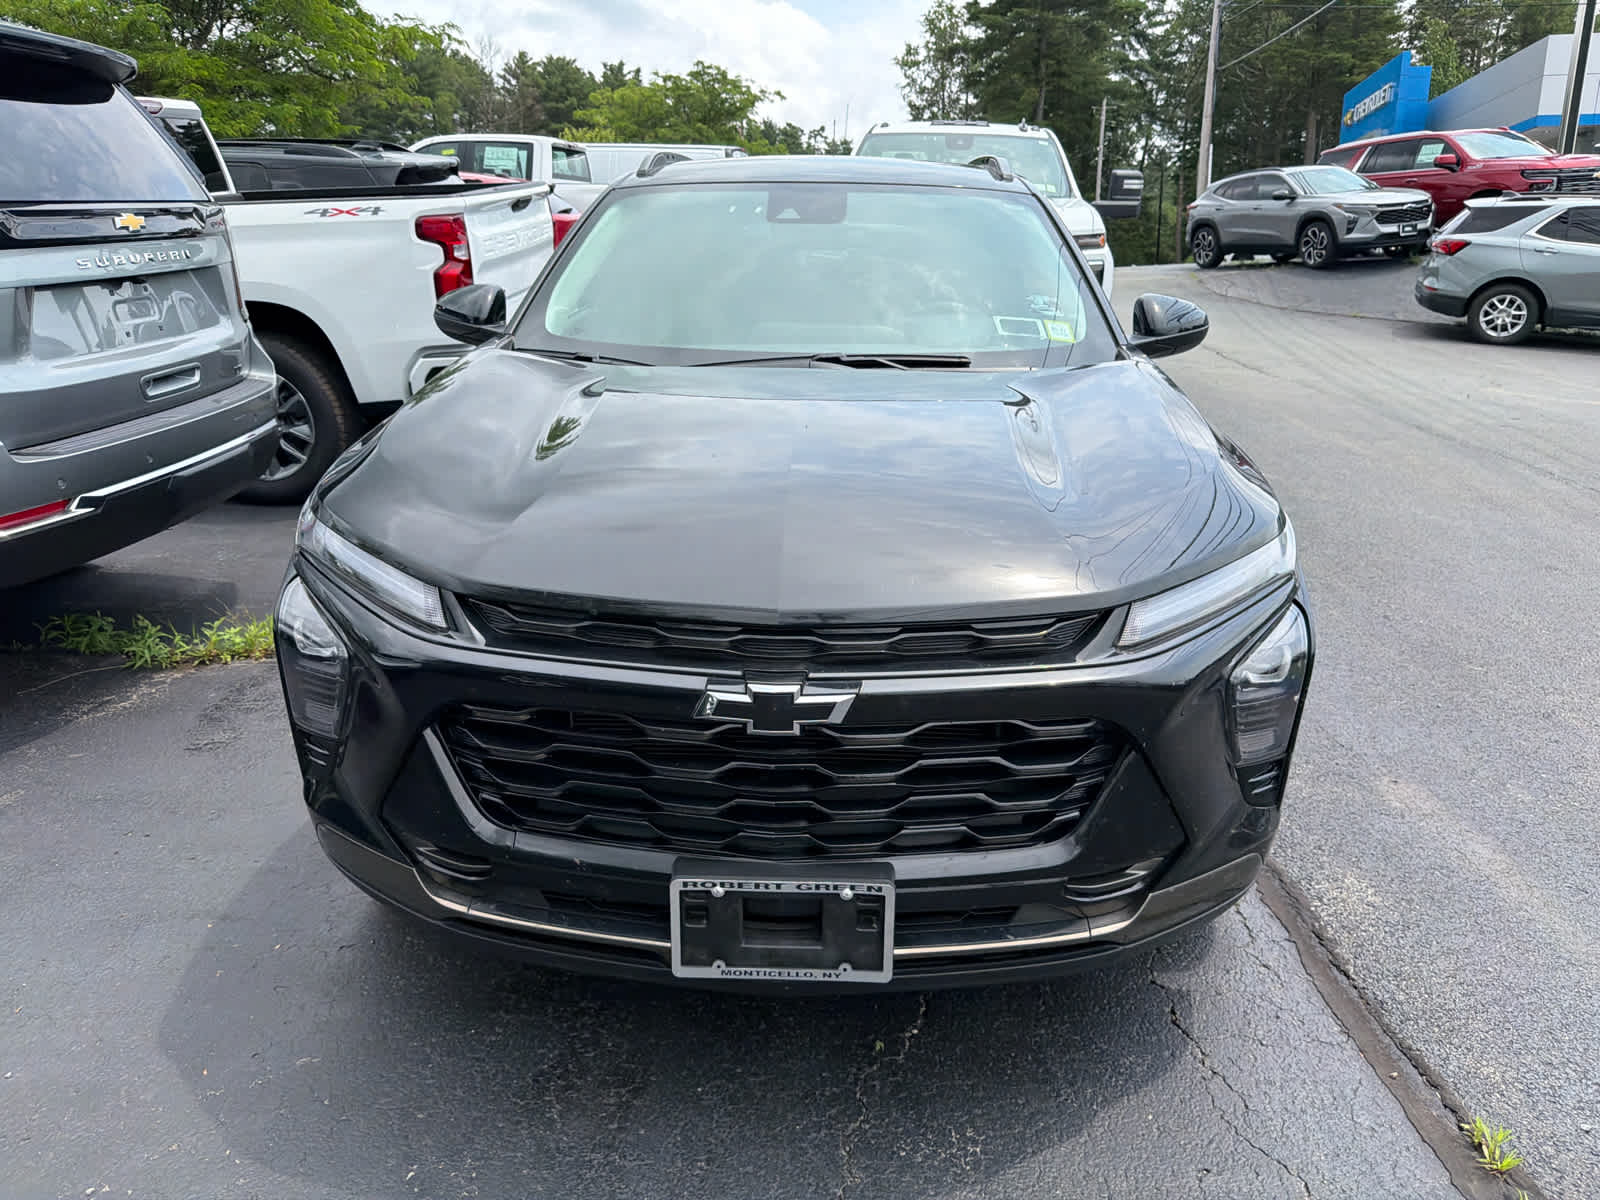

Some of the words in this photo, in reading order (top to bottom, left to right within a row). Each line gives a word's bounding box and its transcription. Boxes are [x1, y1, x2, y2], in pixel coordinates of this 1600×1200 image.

[1353, 82, 1396, 122] CHEVROLET
[76, 248, 192, 270] SUBURBAN
[682, 881, 784, 891] ROBERT
[796, 882, 883, 894] GREEN
[822, 970, 842, 979] NY
